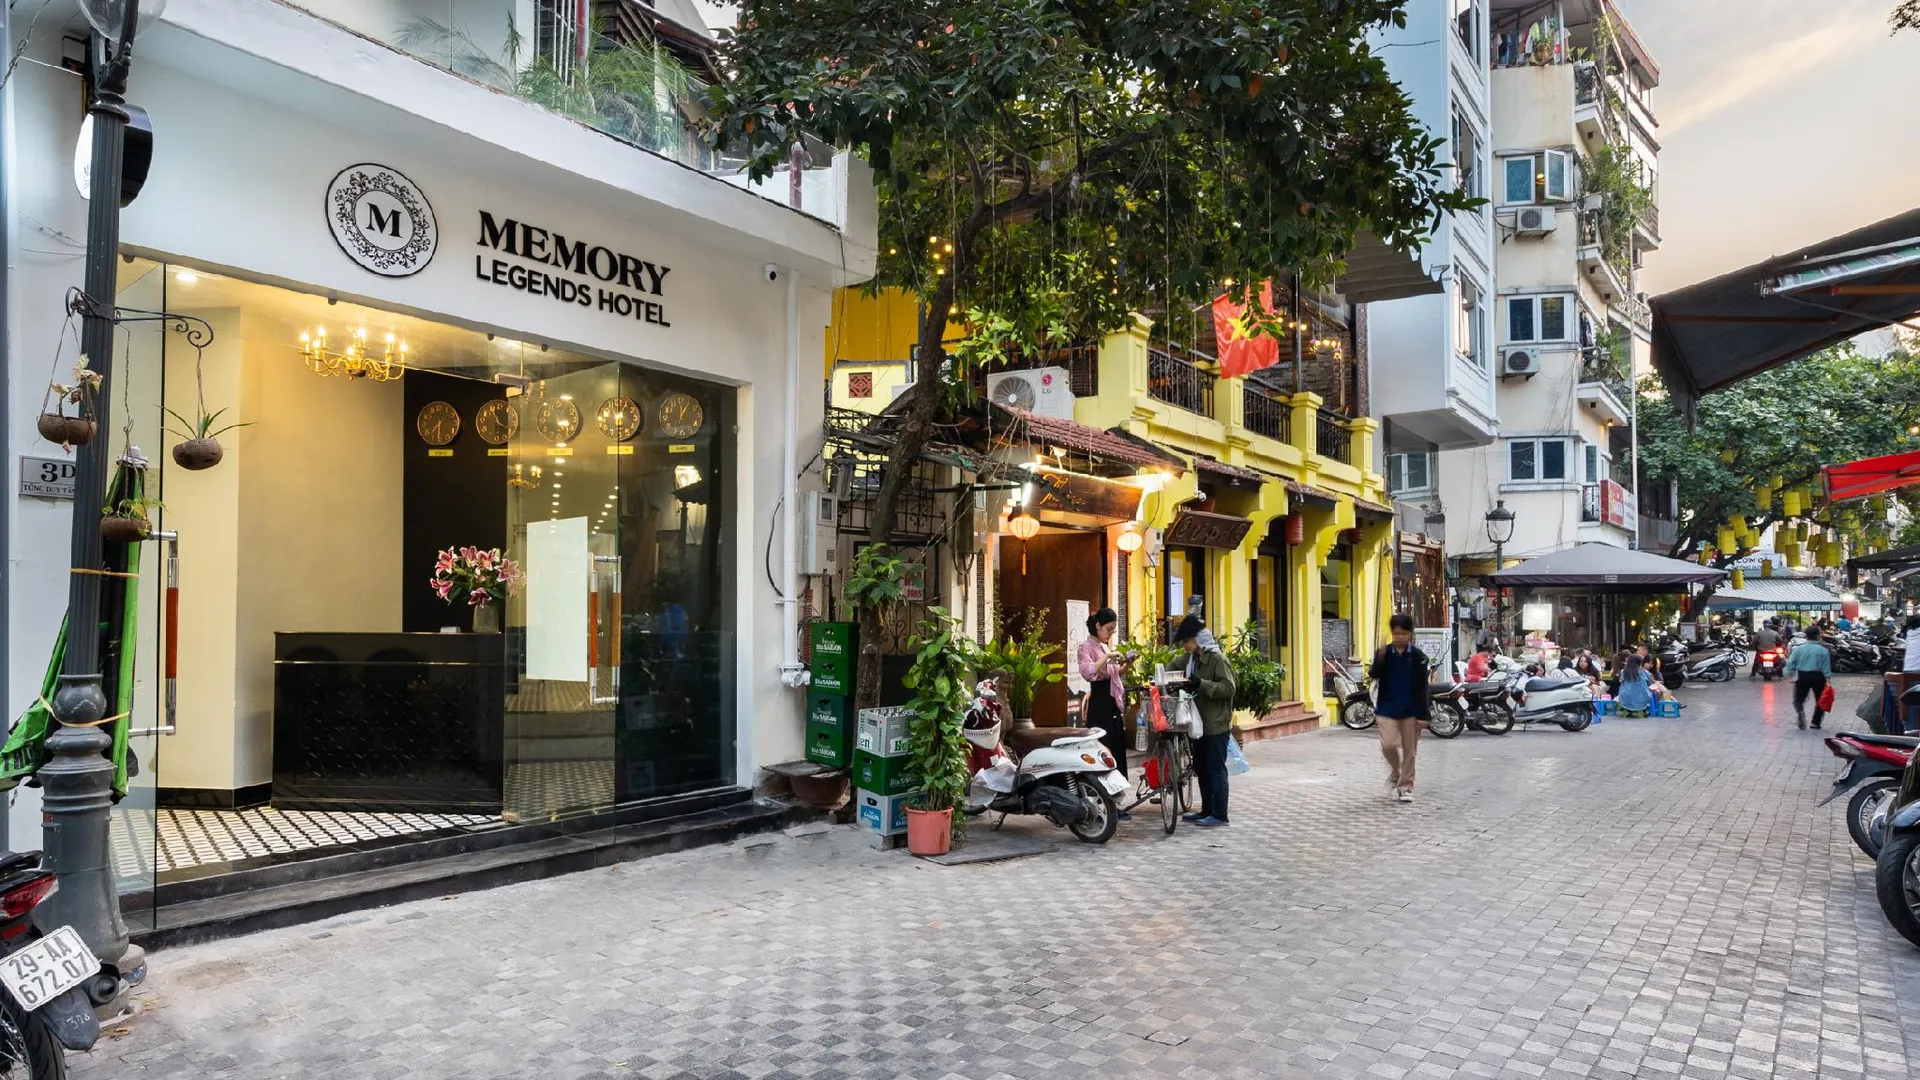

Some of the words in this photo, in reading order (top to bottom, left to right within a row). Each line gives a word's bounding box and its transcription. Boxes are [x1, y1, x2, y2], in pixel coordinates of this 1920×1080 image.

[366, 202, 403, 239] M
[477, 209, 671, 296] MEMORY
[476, 255, 592, 307] LEGENDS
[598, 289, 671, 328] HOTEL
[9, 936, 72, 980] 29-AA
[19, 951, 90, 1004] 672.07
